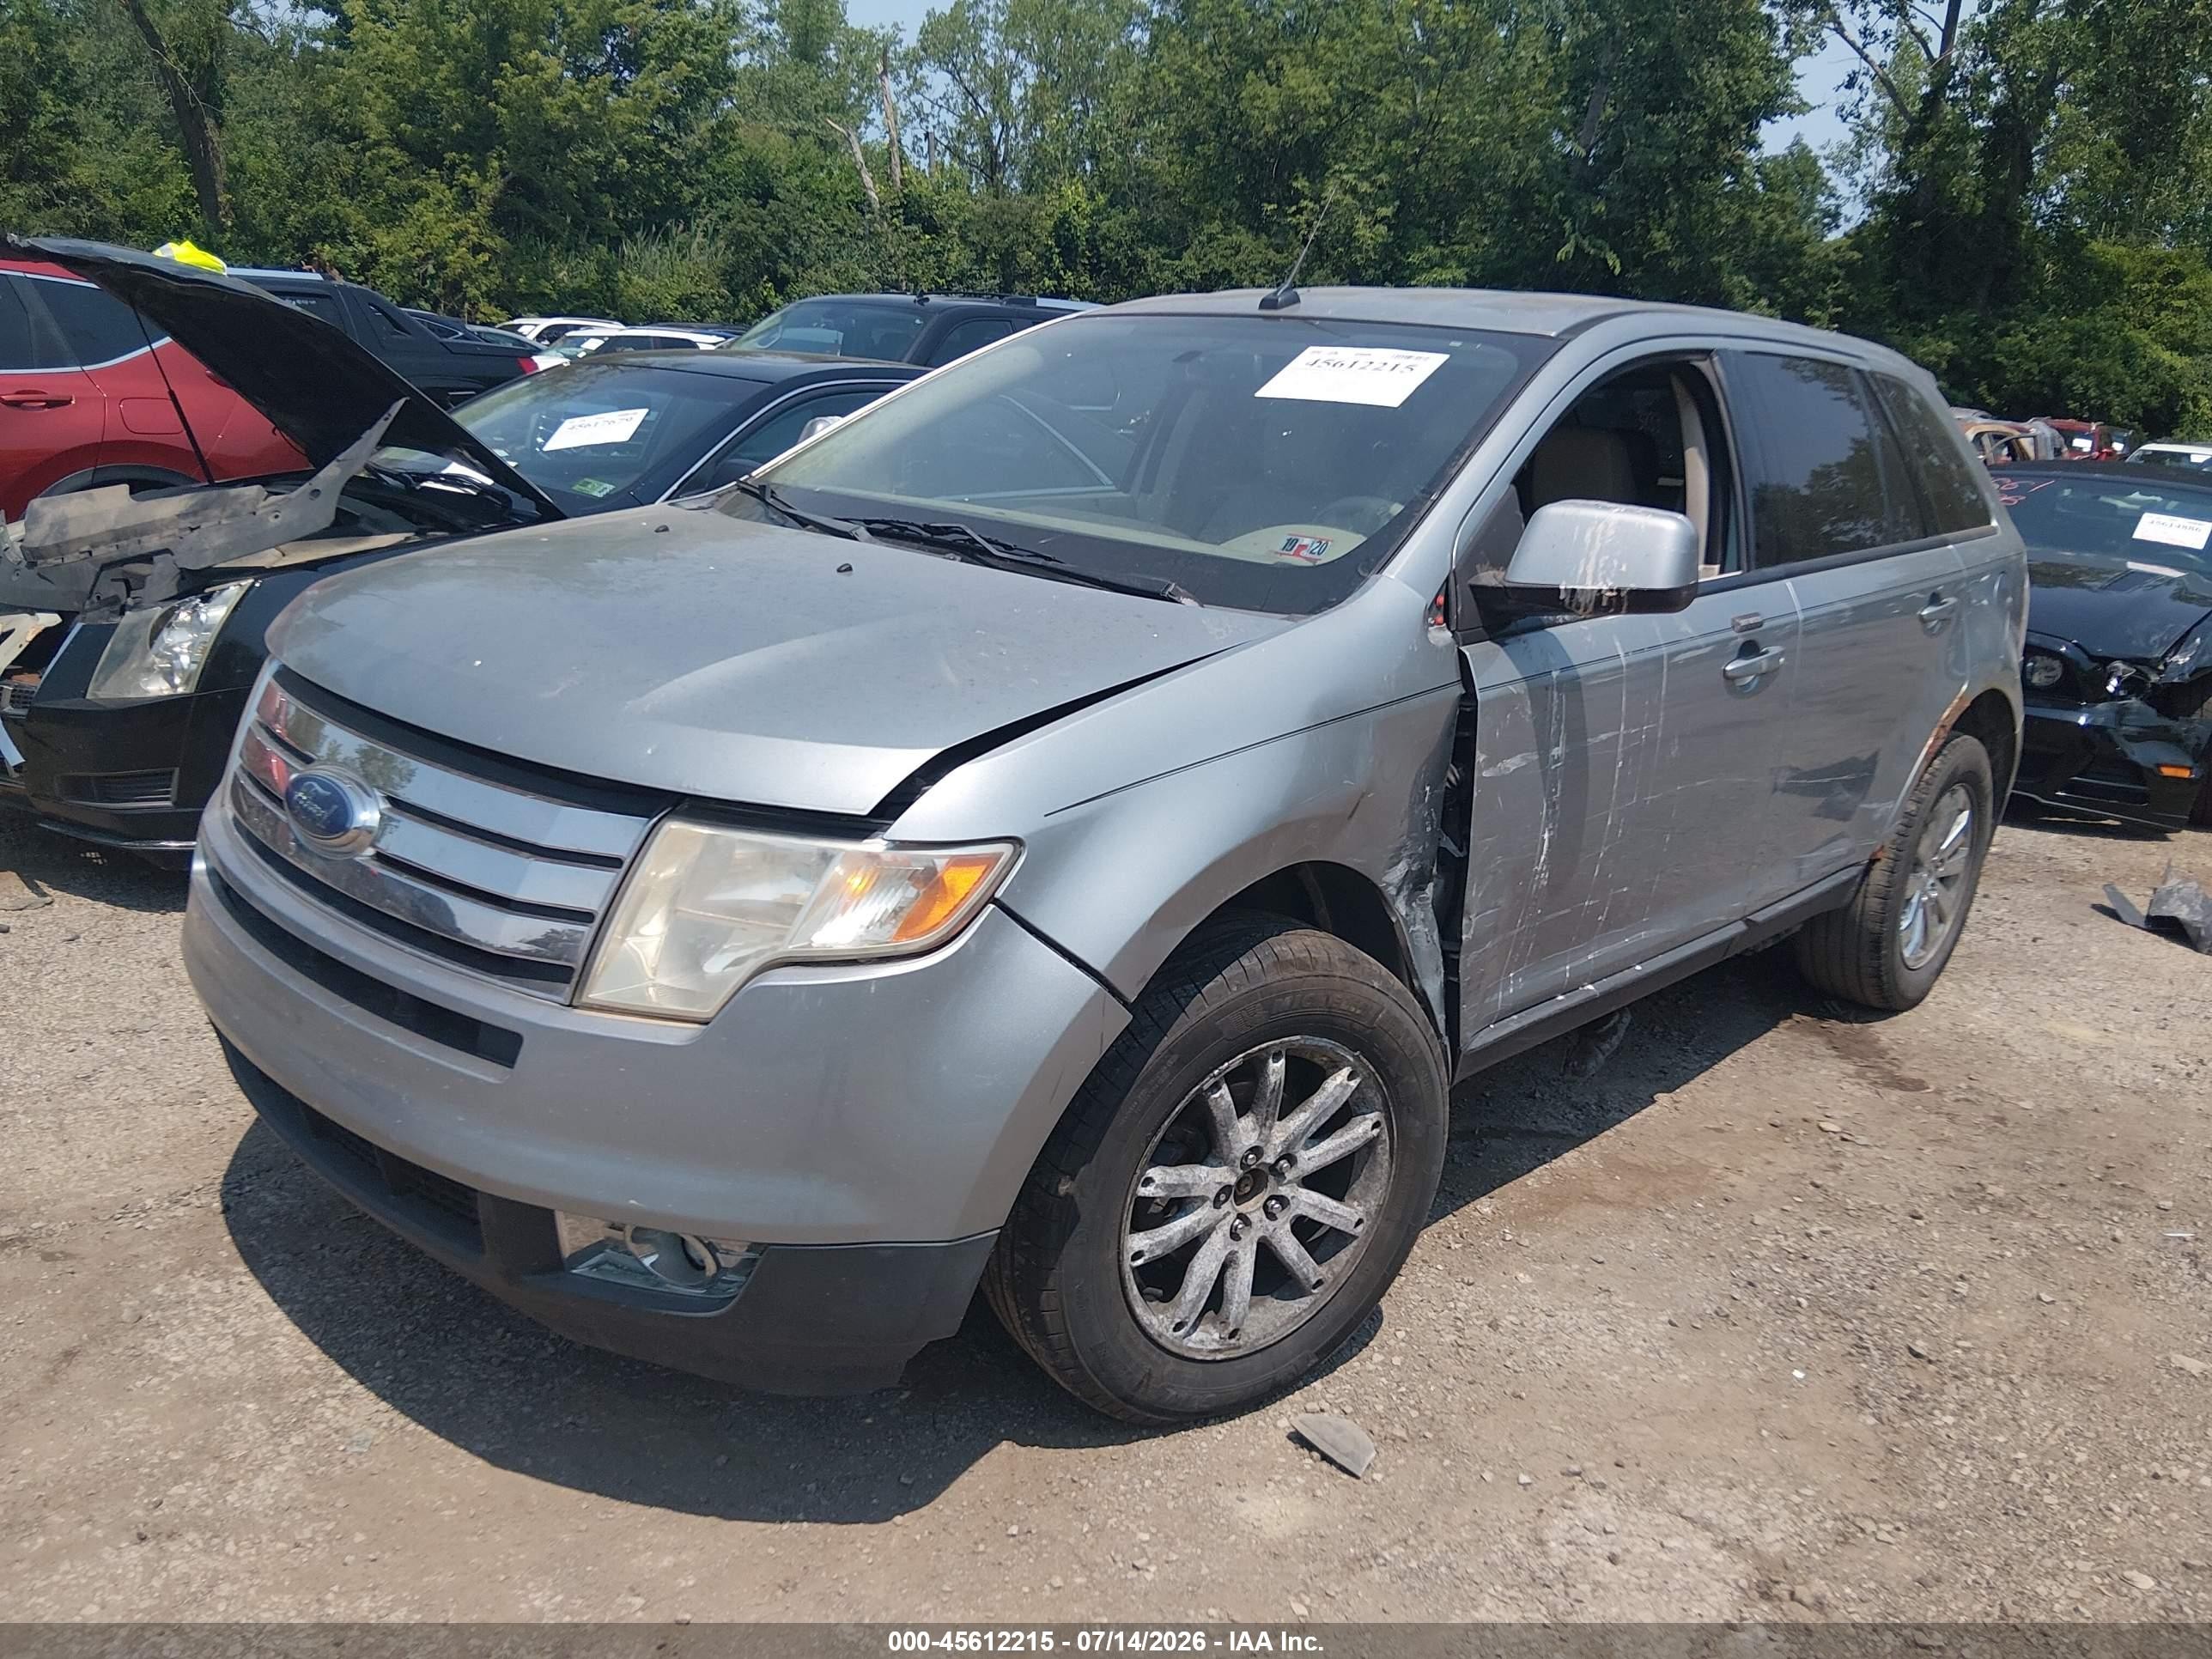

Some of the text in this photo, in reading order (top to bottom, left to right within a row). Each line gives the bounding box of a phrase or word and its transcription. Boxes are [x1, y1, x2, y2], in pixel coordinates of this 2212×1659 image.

[1304, 357, 1419, 374] 45612215
[1280, 537, 1329, 556] 10 20
[294, 781, 339, 830] Ford
